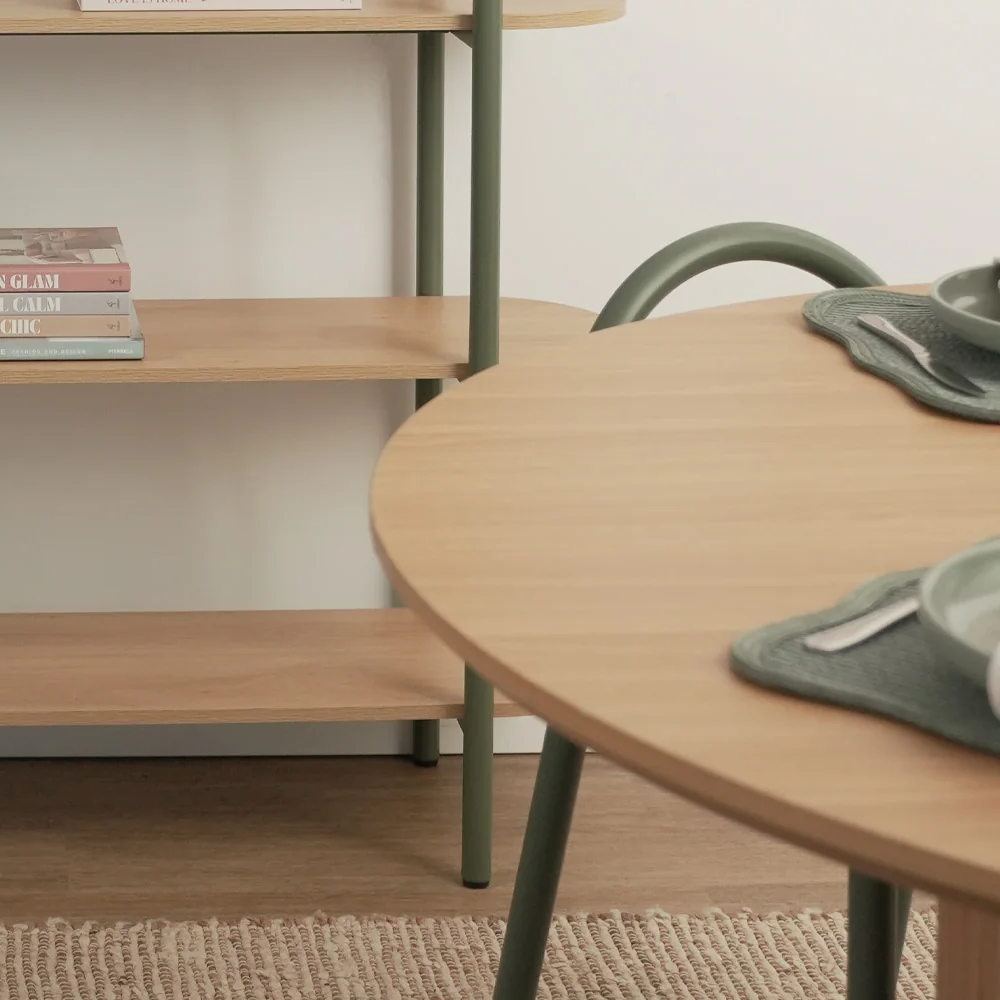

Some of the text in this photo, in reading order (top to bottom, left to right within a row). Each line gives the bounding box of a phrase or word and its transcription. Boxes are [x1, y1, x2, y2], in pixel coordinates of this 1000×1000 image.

[10, 274, 59, 289] GLAM
[12, 297, 61, 312] CALM
[0, 319, 41, 334] CHIC
